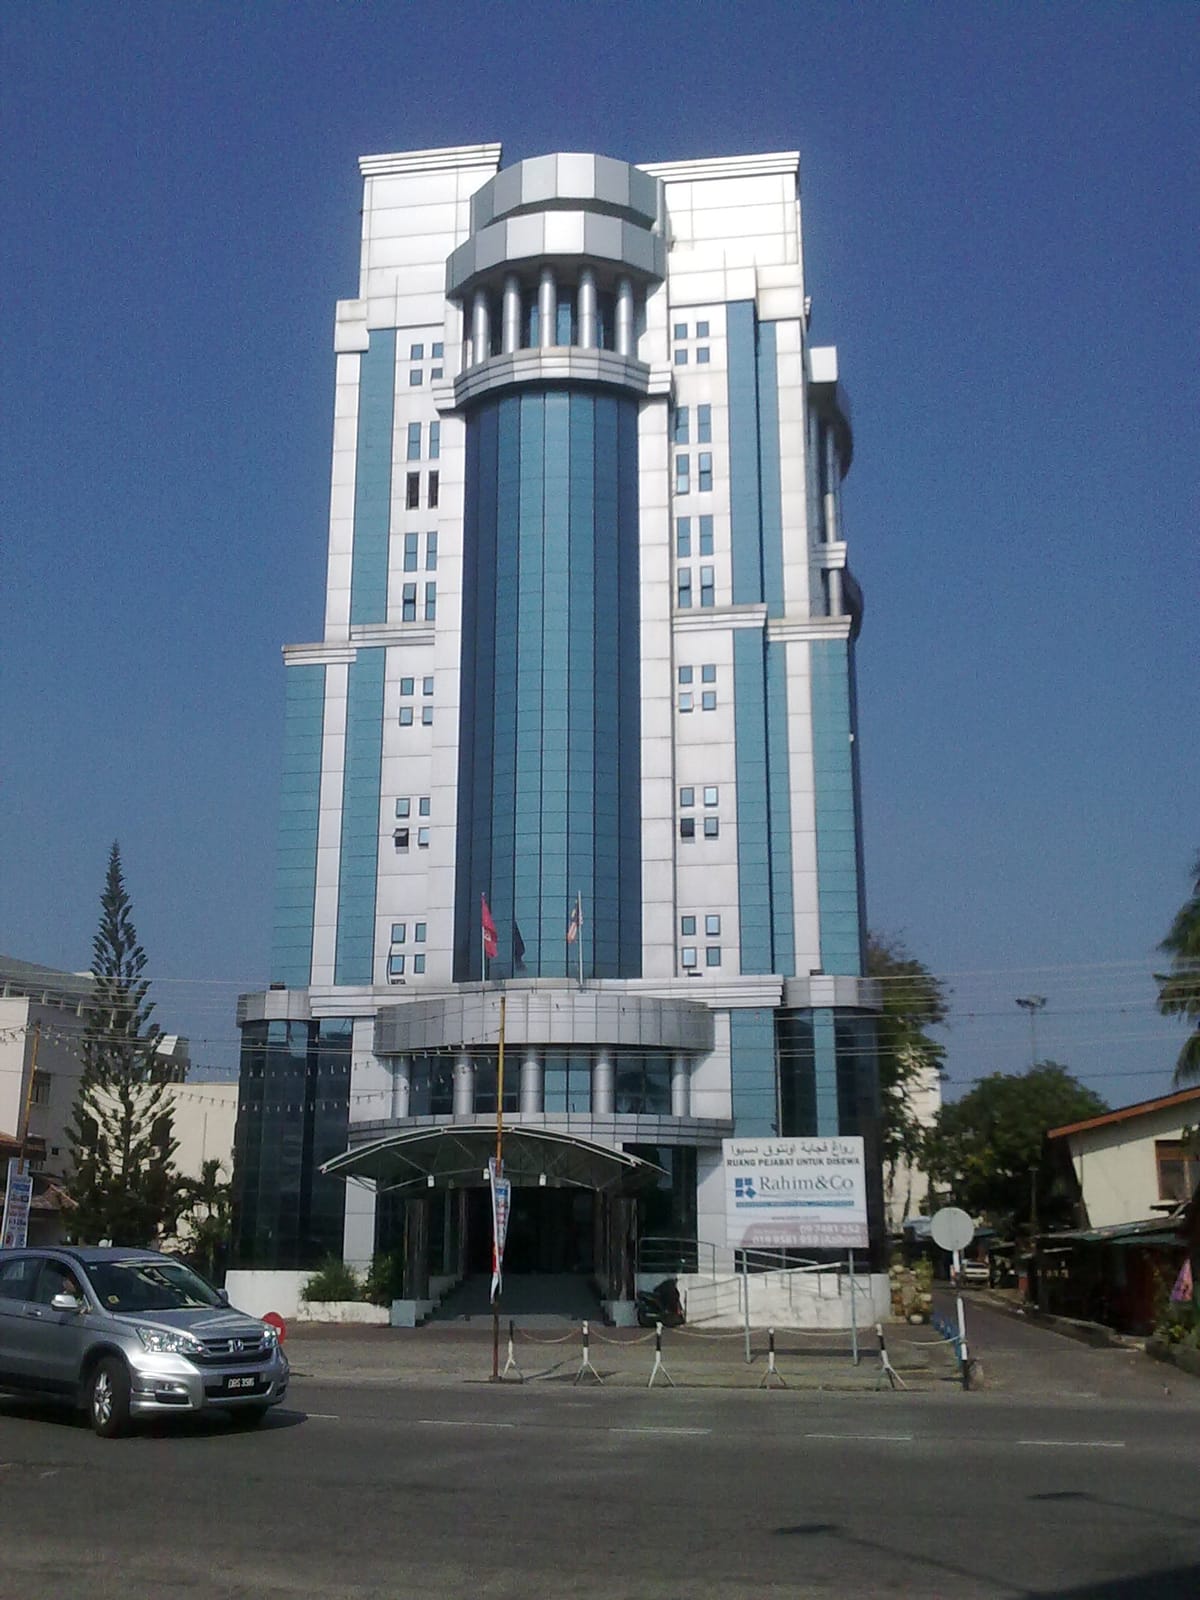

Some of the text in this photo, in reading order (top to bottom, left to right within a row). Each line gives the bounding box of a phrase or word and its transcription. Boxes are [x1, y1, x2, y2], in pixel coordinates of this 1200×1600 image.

[727, 1157, 860, 1167] RUANG PEJABAT UNTUK DISEWA
[759, 1175, 854, 1191] Rahim&Co
